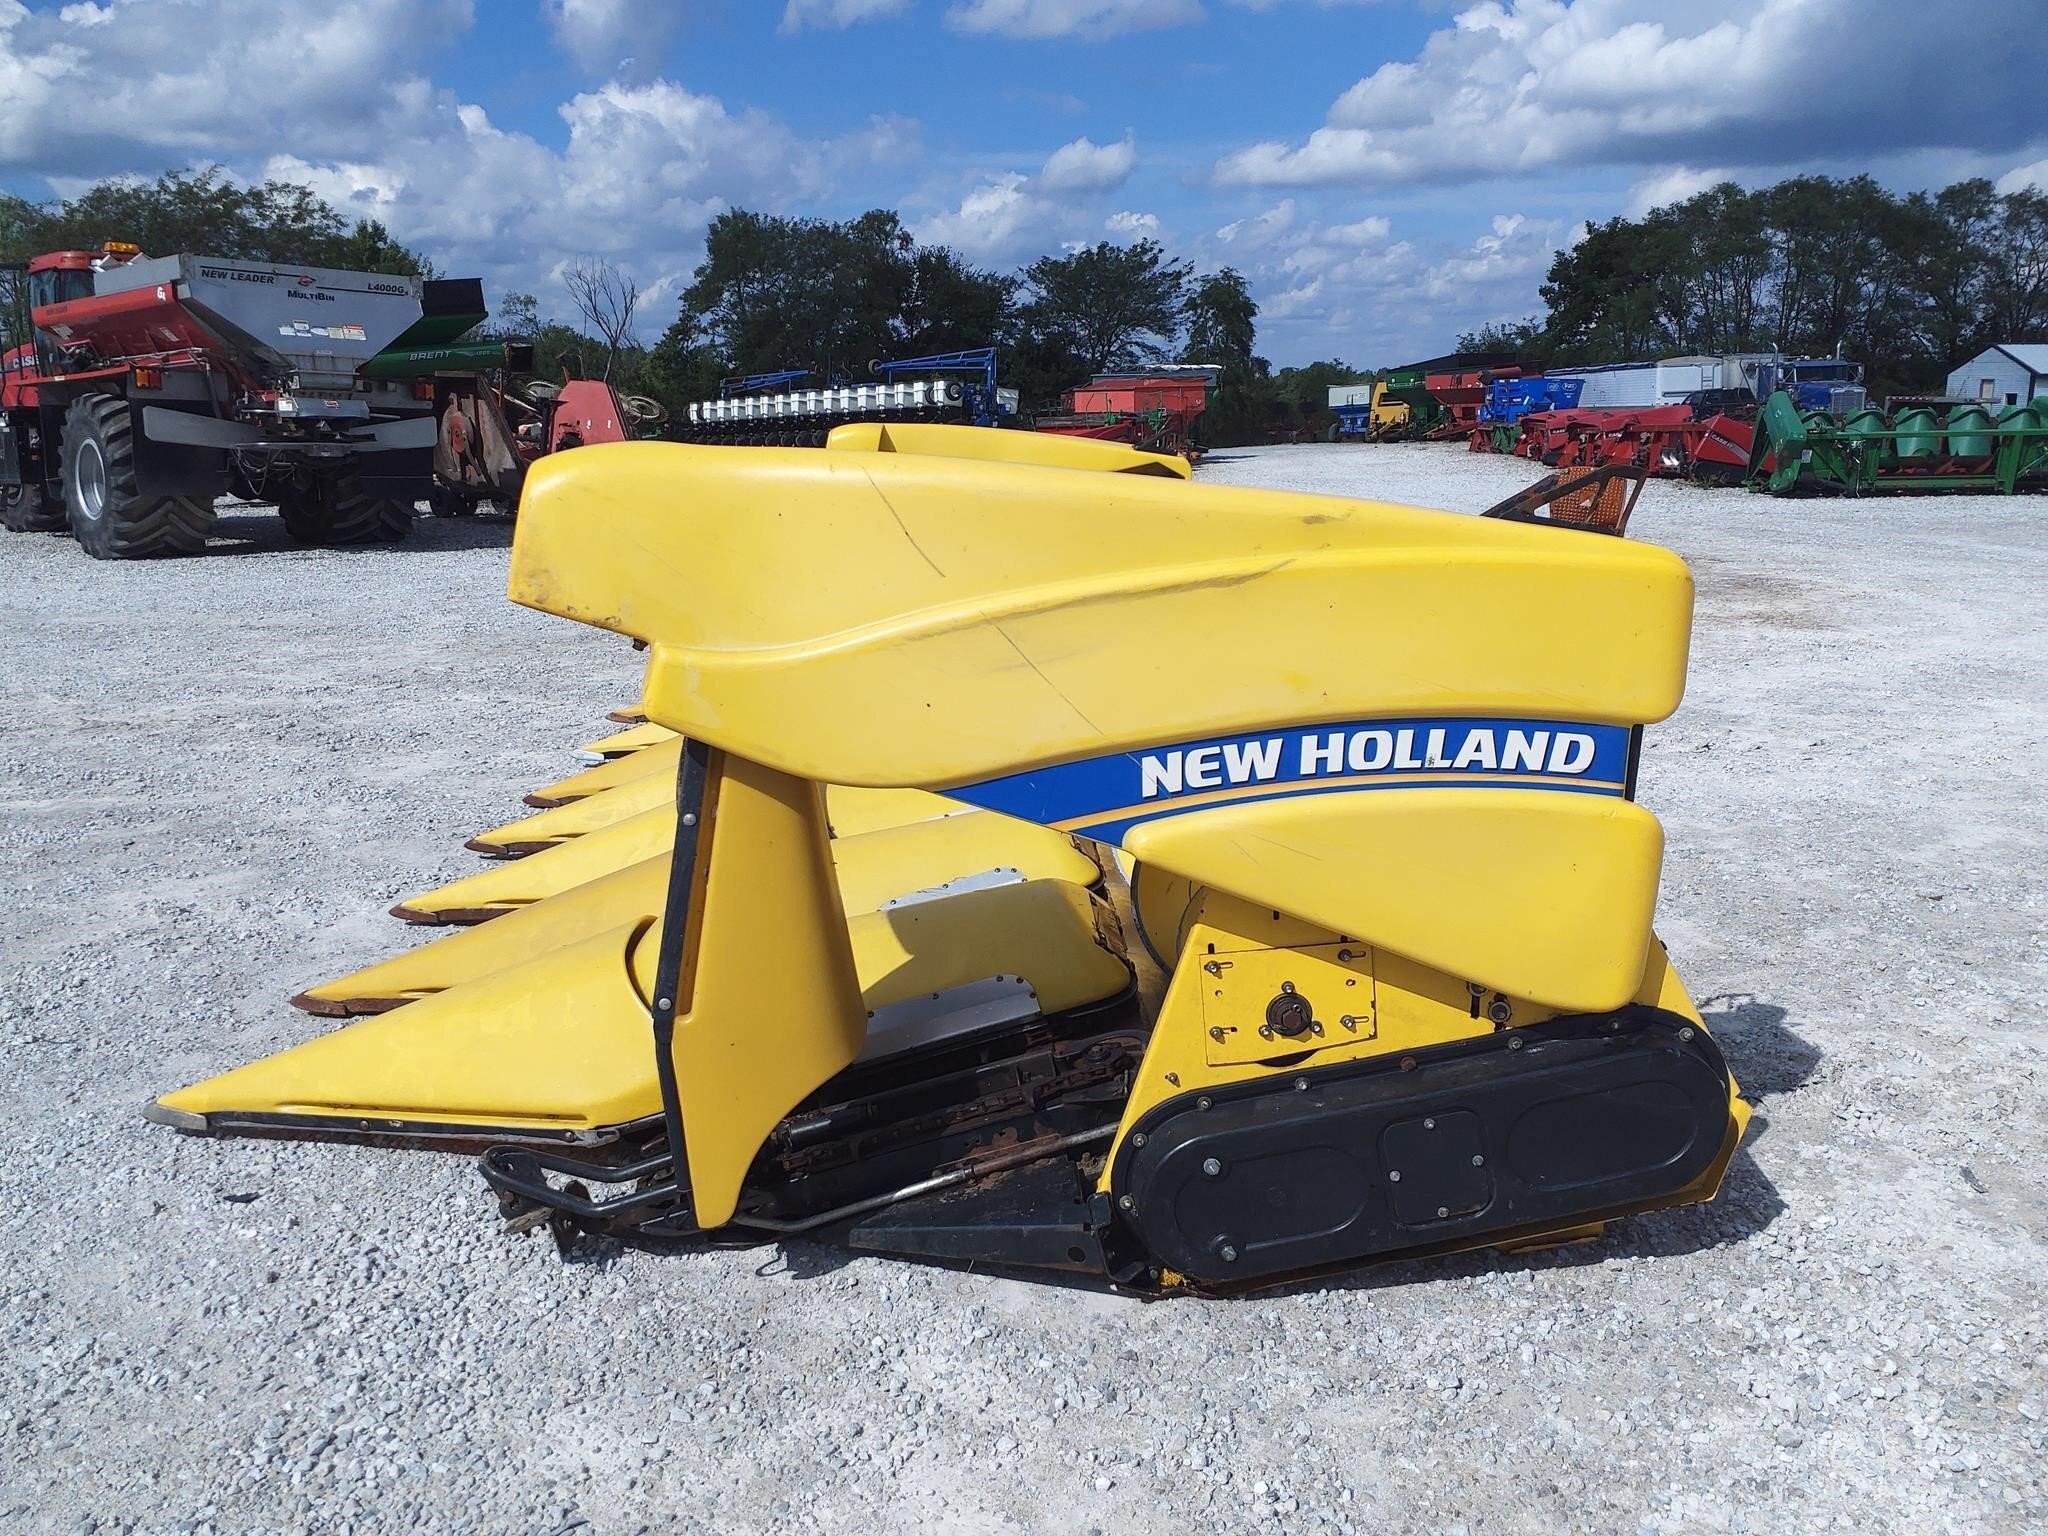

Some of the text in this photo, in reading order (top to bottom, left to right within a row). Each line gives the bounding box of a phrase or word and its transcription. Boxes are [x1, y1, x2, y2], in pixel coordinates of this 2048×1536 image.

[201, 269, 275, 285] NEW LEADER
[1141, 728, 1596, 798] NEW HOLLAND
